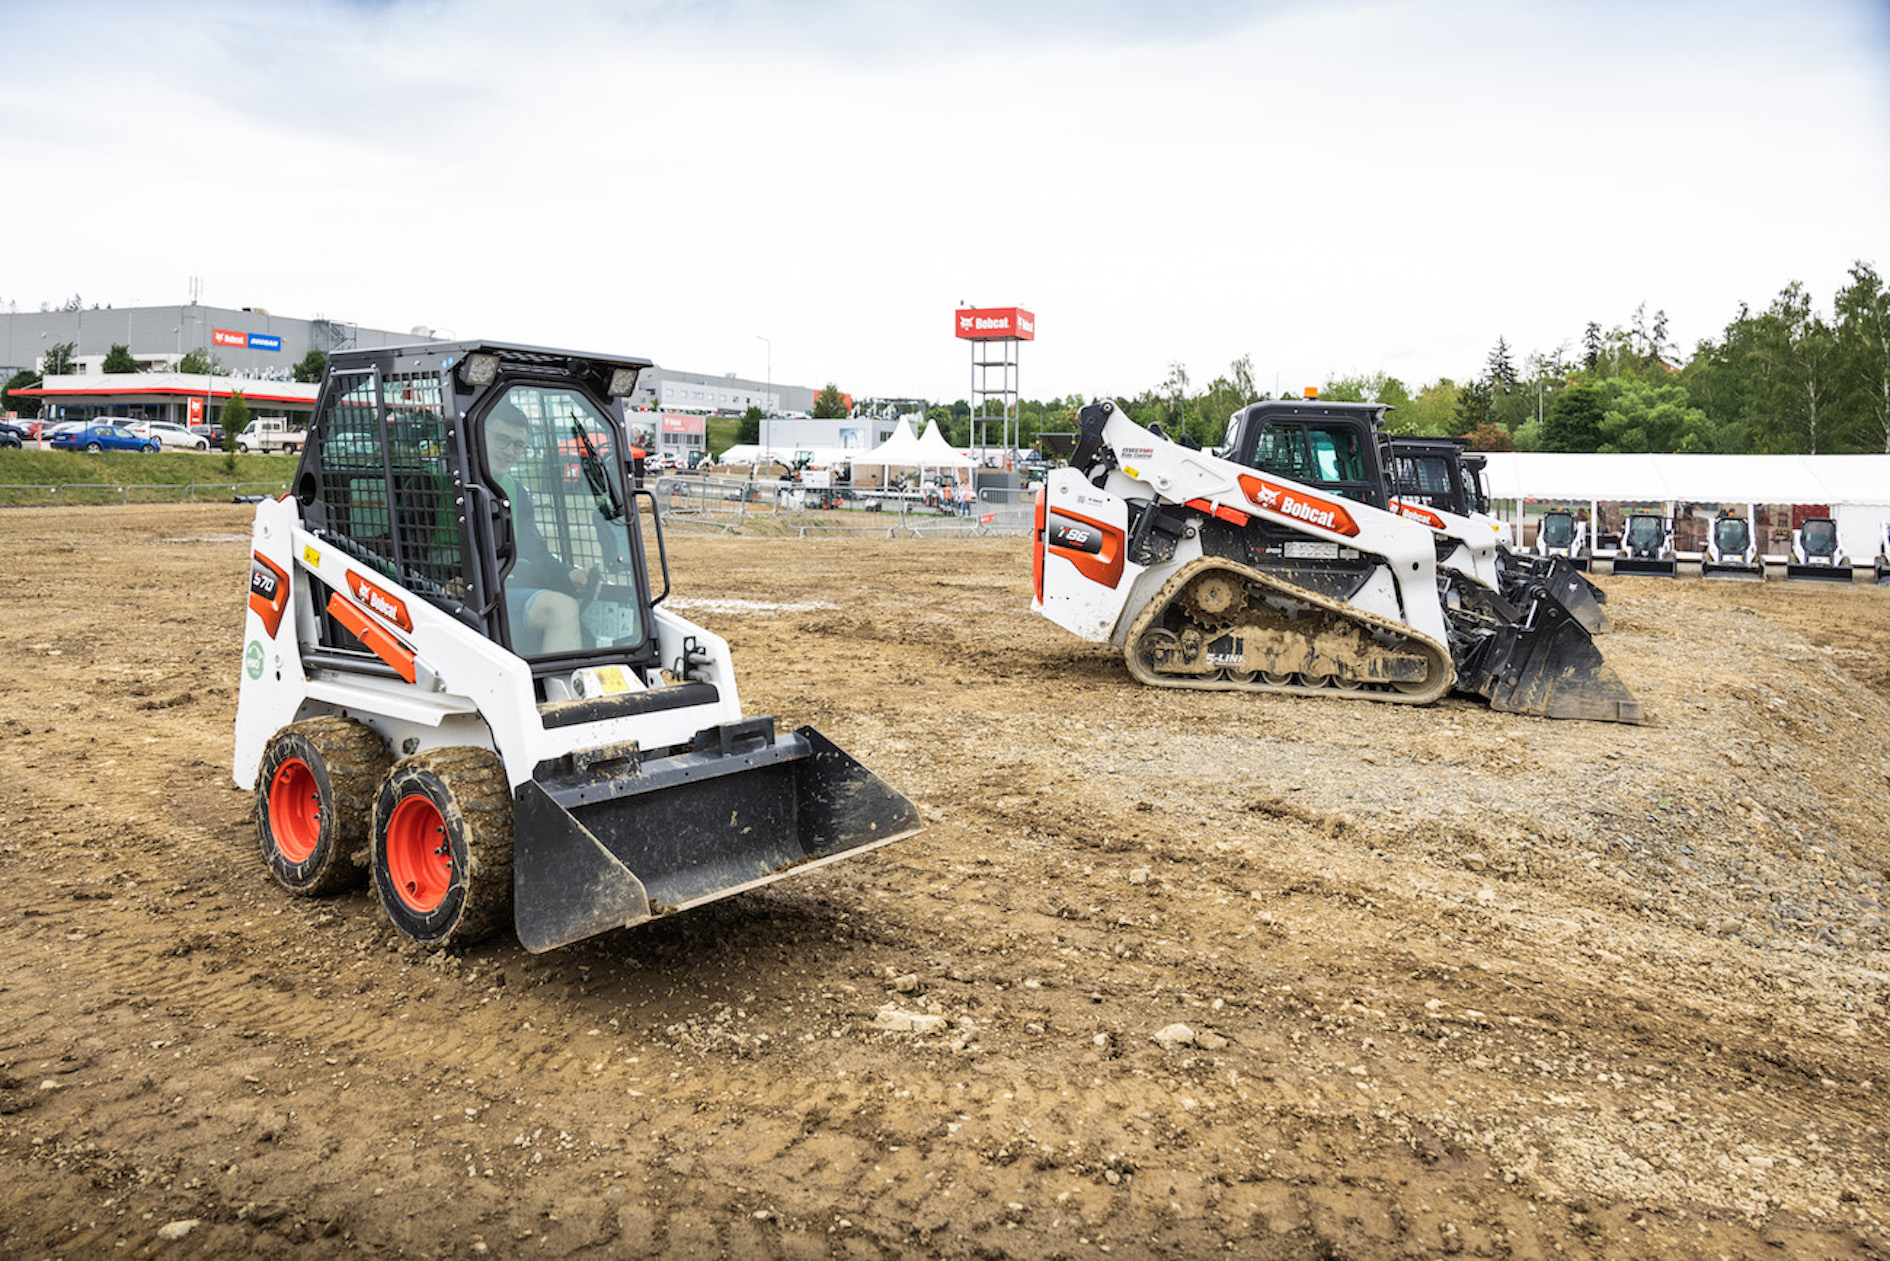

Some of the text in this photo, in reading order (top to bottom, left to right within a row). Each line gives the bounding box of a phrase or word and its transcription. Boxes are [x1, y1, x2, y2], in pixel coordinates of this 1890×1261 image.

[975, 317, 1009, 329] Bobcat
[250, 338, 279, 347] DOOSAN
[1280, 496, 1335, 528] Bobcat
[1402, 508, 1431, 524] Bobcat
[1058, 525, 1091, 543] T86
[253, 572, 275, 592] S70
[370, 591, 398, 621] Bobcat
